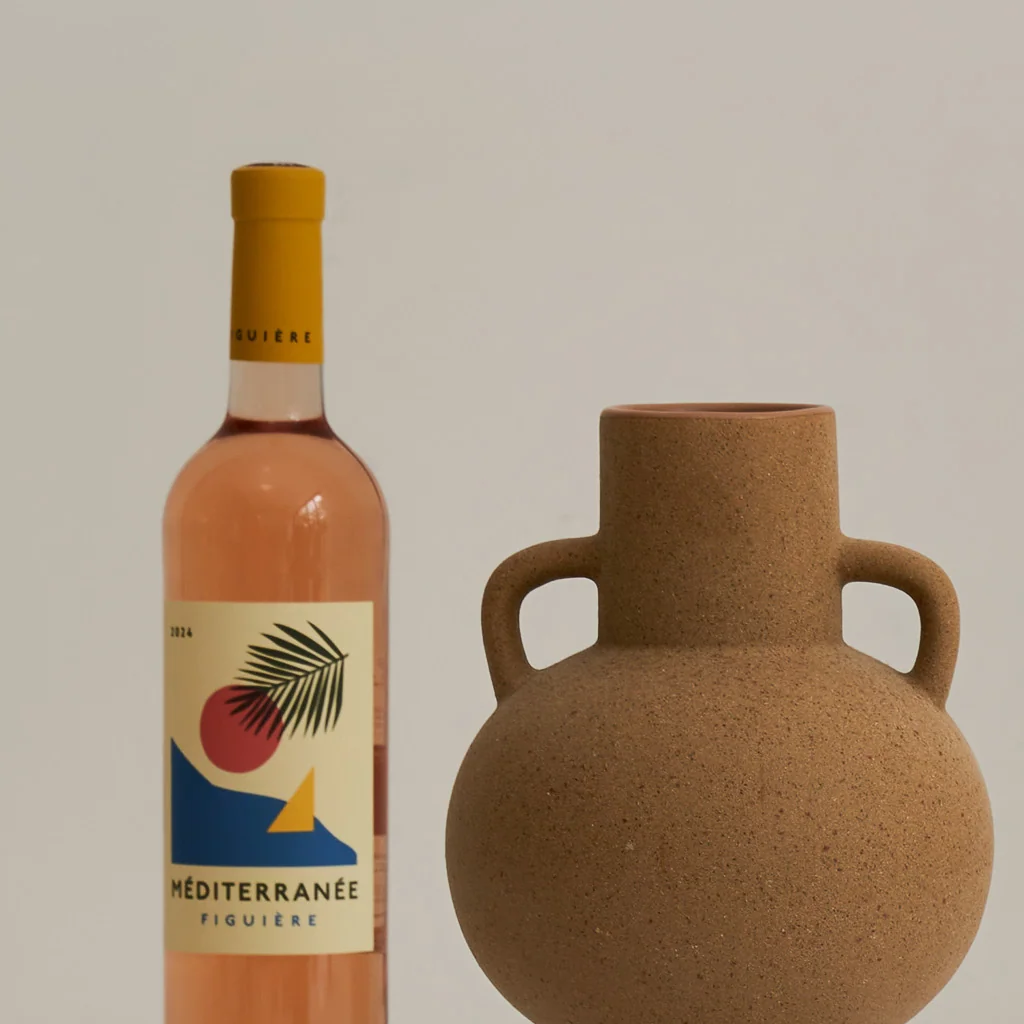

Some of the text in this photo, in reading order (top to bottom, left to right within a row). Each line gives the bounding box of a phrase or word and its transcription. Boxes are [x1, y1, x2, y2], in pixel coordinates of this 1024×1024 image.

[170, 626, 193, 638] 2024
[171, 876, 359, 902] MÉDITERRANÉE
[201, 912, 317, 927] FIGUIÈRE
